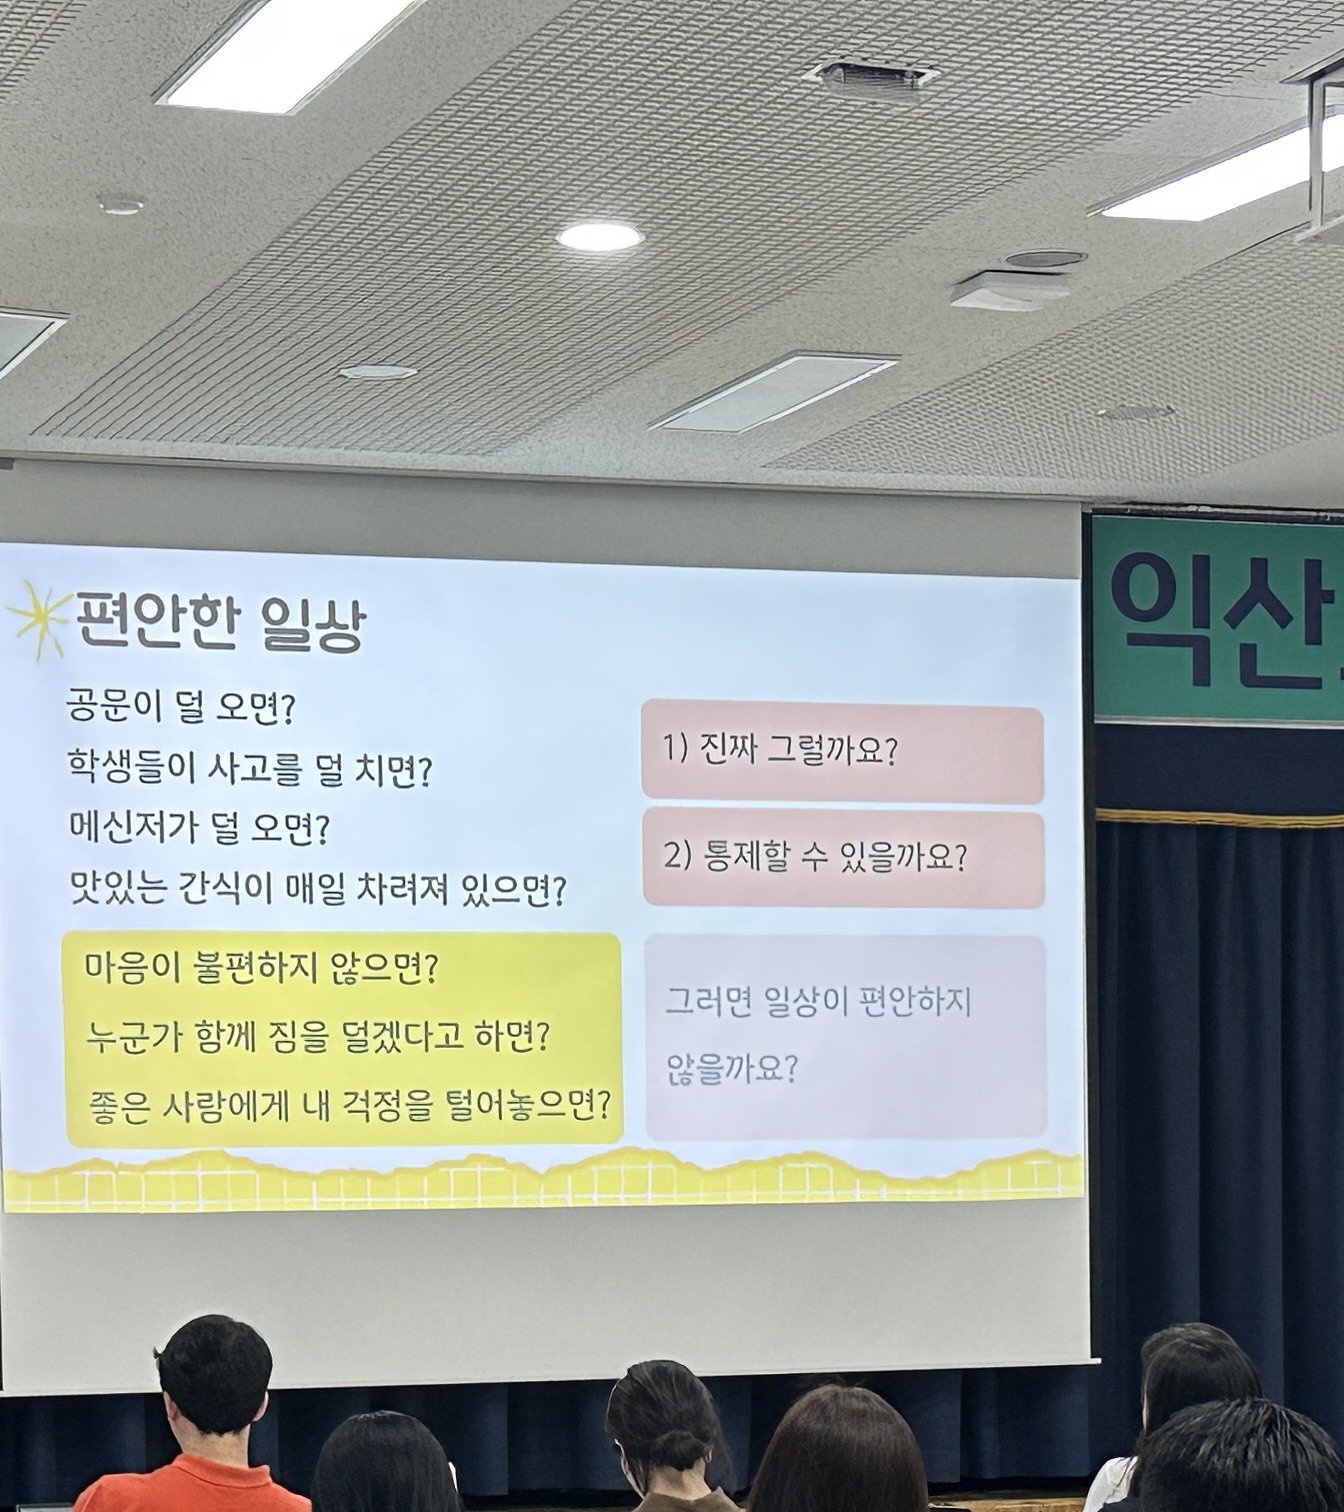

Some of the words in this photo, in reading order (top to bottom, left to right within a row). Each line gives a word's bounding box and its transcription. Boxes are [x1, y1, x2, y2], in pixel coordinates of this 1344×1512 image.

[76, 591, 243, 651] 편안한
[261, 596, 368, 655] 일상
[66, 687, 162, 723] 공문이
[176, 689, 204, 725] 덜
[216, 691, 296, 727] 오면?
[663, 731, 688, 764] 1)
[700, 731, 759, 765] 진짜
[767, 734, 898, 767] 그럴까요?
[67, 747, 195, 785] 학생들이
[207, 751, 303, 787] 사고를
[355, 753, 433, 790] 치면?
[70, 809, 200, 845] 메신저가
[211, 811, 239, 846] 덜
[251, 812, 330, 847] 오면?
[664, 839, 692, 871] 2)
[704, 839, 792, 873] 통제할
[801, 841, 829, 873] 수
[840, 841, 968, 874] 있을까요?
[70, 869, 169, 906] 맛있는
[179, 870, 272, 906] 간식이
[286, 871, 346, 907] 매일
[357, 871, 448, 907] 차려져
[461, 873, 567, 908] 있으면?
[85, 950, 180, 986] 마음이
[193, 950, 317, 985] 불편하지
[330, 951, 439, 986] 않으면?
[665, 985, 752, 1019] 그러면
[764, 985, 848, 1019] 일상이
[859, 984, 971, 1018] 편안하지
[86, 1020, 184, 1056] 누군가
[194, 1019, 256, 1054] 함께
[269, 1020, 330, 1054] 짐을
[342, 1020, 465, 1054] 덜겠다고
[474, 1019, 550, 1054] 하면?
[667, 1052, 799, 1087] 않을까요?
[89, 1091, 152, 1126] 좋은
[162, 1089, 289, 1125] 사람에게
[303, 1089, 330, 1123] 내
[343, 1089, 434, 1124] 걱정을
[446, 1088, 611, 1123] 털어놓으면?
